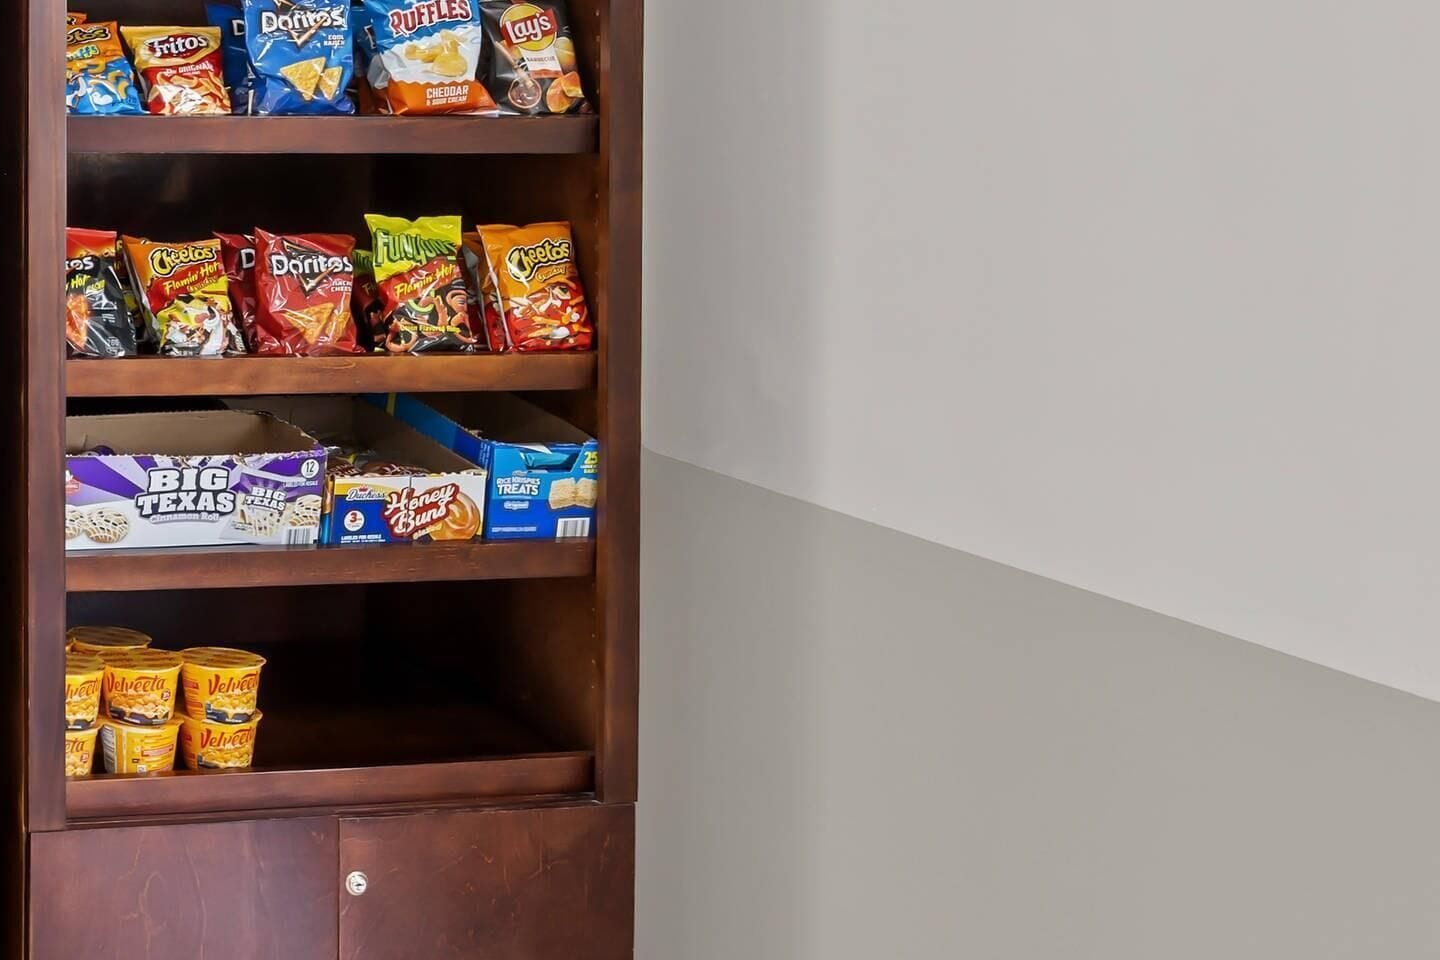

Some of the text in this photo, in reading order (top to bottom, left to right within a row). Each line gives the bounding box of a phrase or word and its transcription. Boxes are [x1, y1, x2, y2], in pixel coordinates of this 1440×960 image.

[262, 5, 345, 33] Doritos
[505, 13, 552, 44] Lay's
[144, 34, 208, 57] Fritos
[426, 85, 469, 98] CHEDDAR
[151, 246, 215, 276] Cheetos
[272, 254, 352, 276] Doritos
[508, 240, 571, 278] Cheetos
[305, 461, 316, 474] 12
[148, 468, 230, 493] BIG
[498, 484, 539, 496] TREATS
[137, 492, 236, 517] TEXAS
[246, 496, 286, 511] TEXAS
[251, 487, 286, 501] BIG
[385, 484, 455, 516] Honey
[349, 512, 357, 523] 3
[391, 501, 448, 533] Buns
[107, 672, 166, 693] Velveeta
